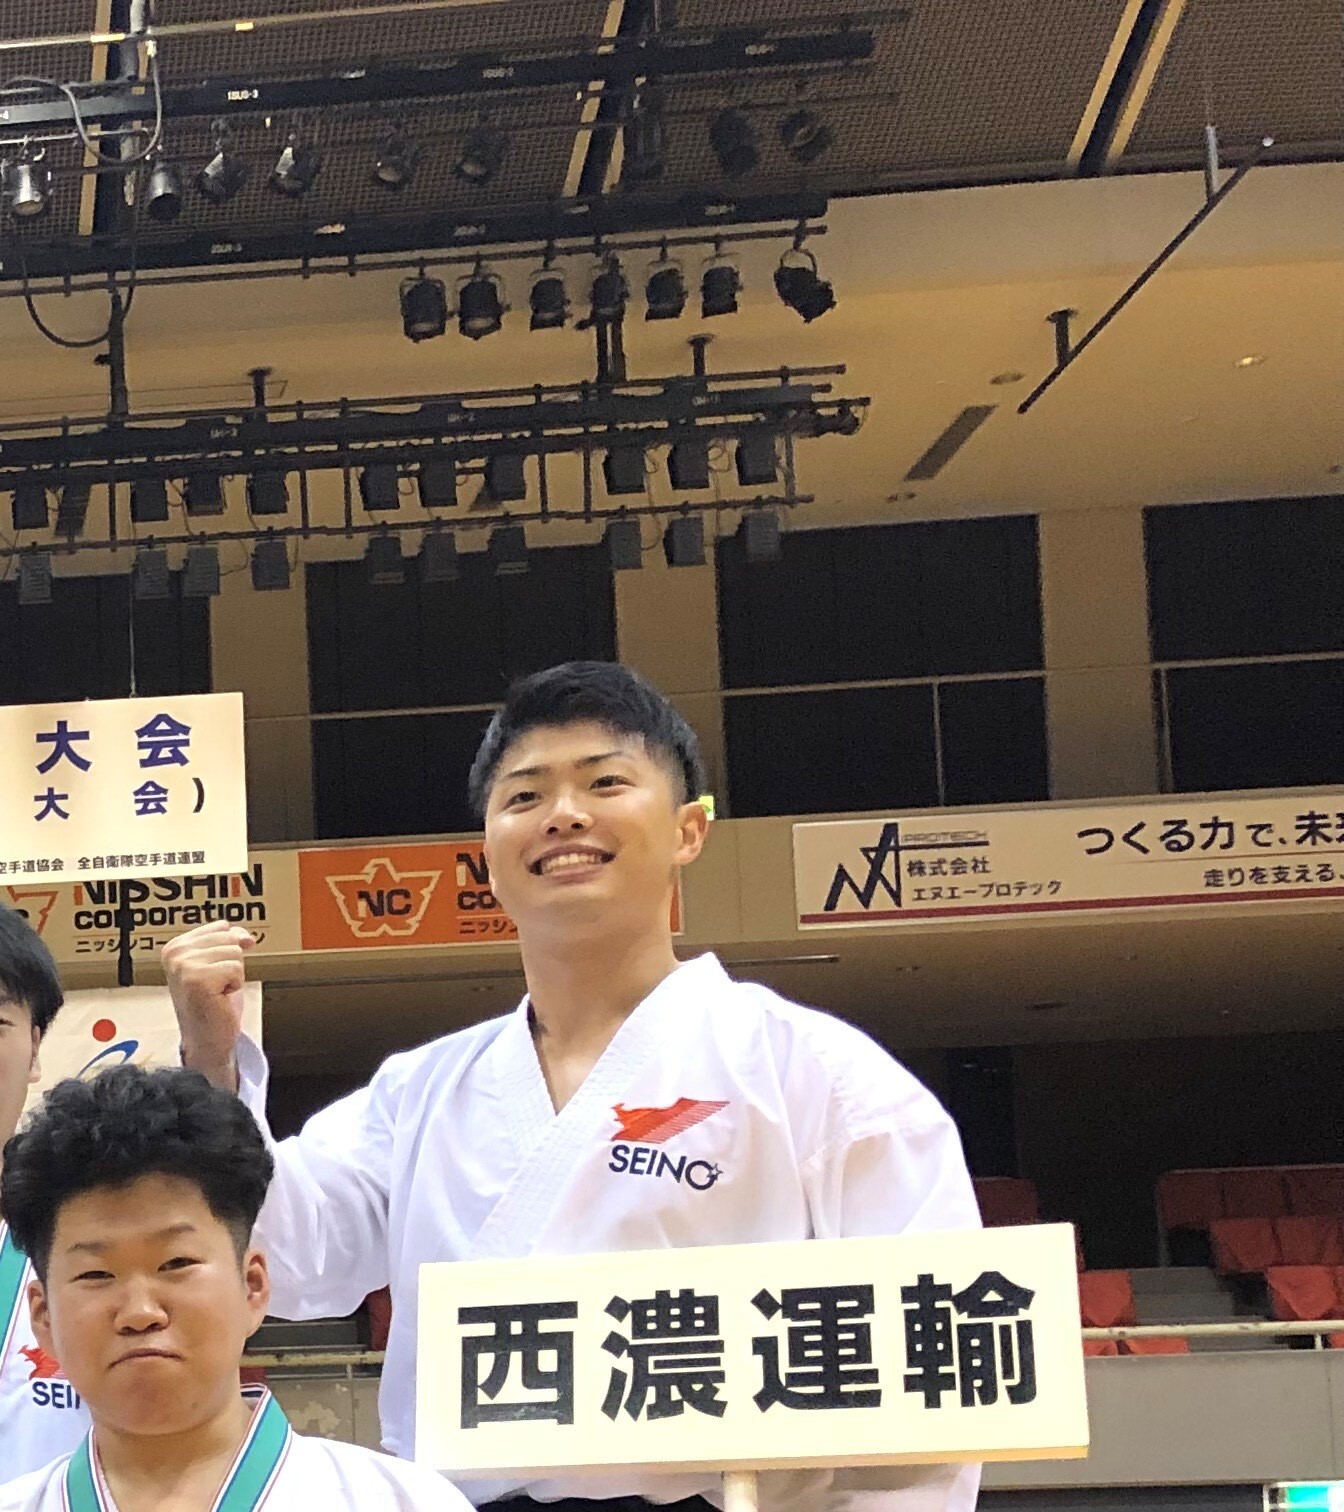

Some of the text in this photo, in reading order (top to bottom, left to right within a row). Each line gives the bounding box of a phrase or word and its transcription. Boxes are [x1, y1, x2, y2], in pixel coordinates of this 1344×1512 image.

[1076, 810, 1344, 856] つくる力で、未
[906, 856, 992, 877] 株式会社
[357, 888, 411, 917] NC
[913, 878, 1062, 902] エヌエープロテック
[608, 1143, 721, 1191] SEINO
[457, 1269, 1039, 1430] 西濃運輸
